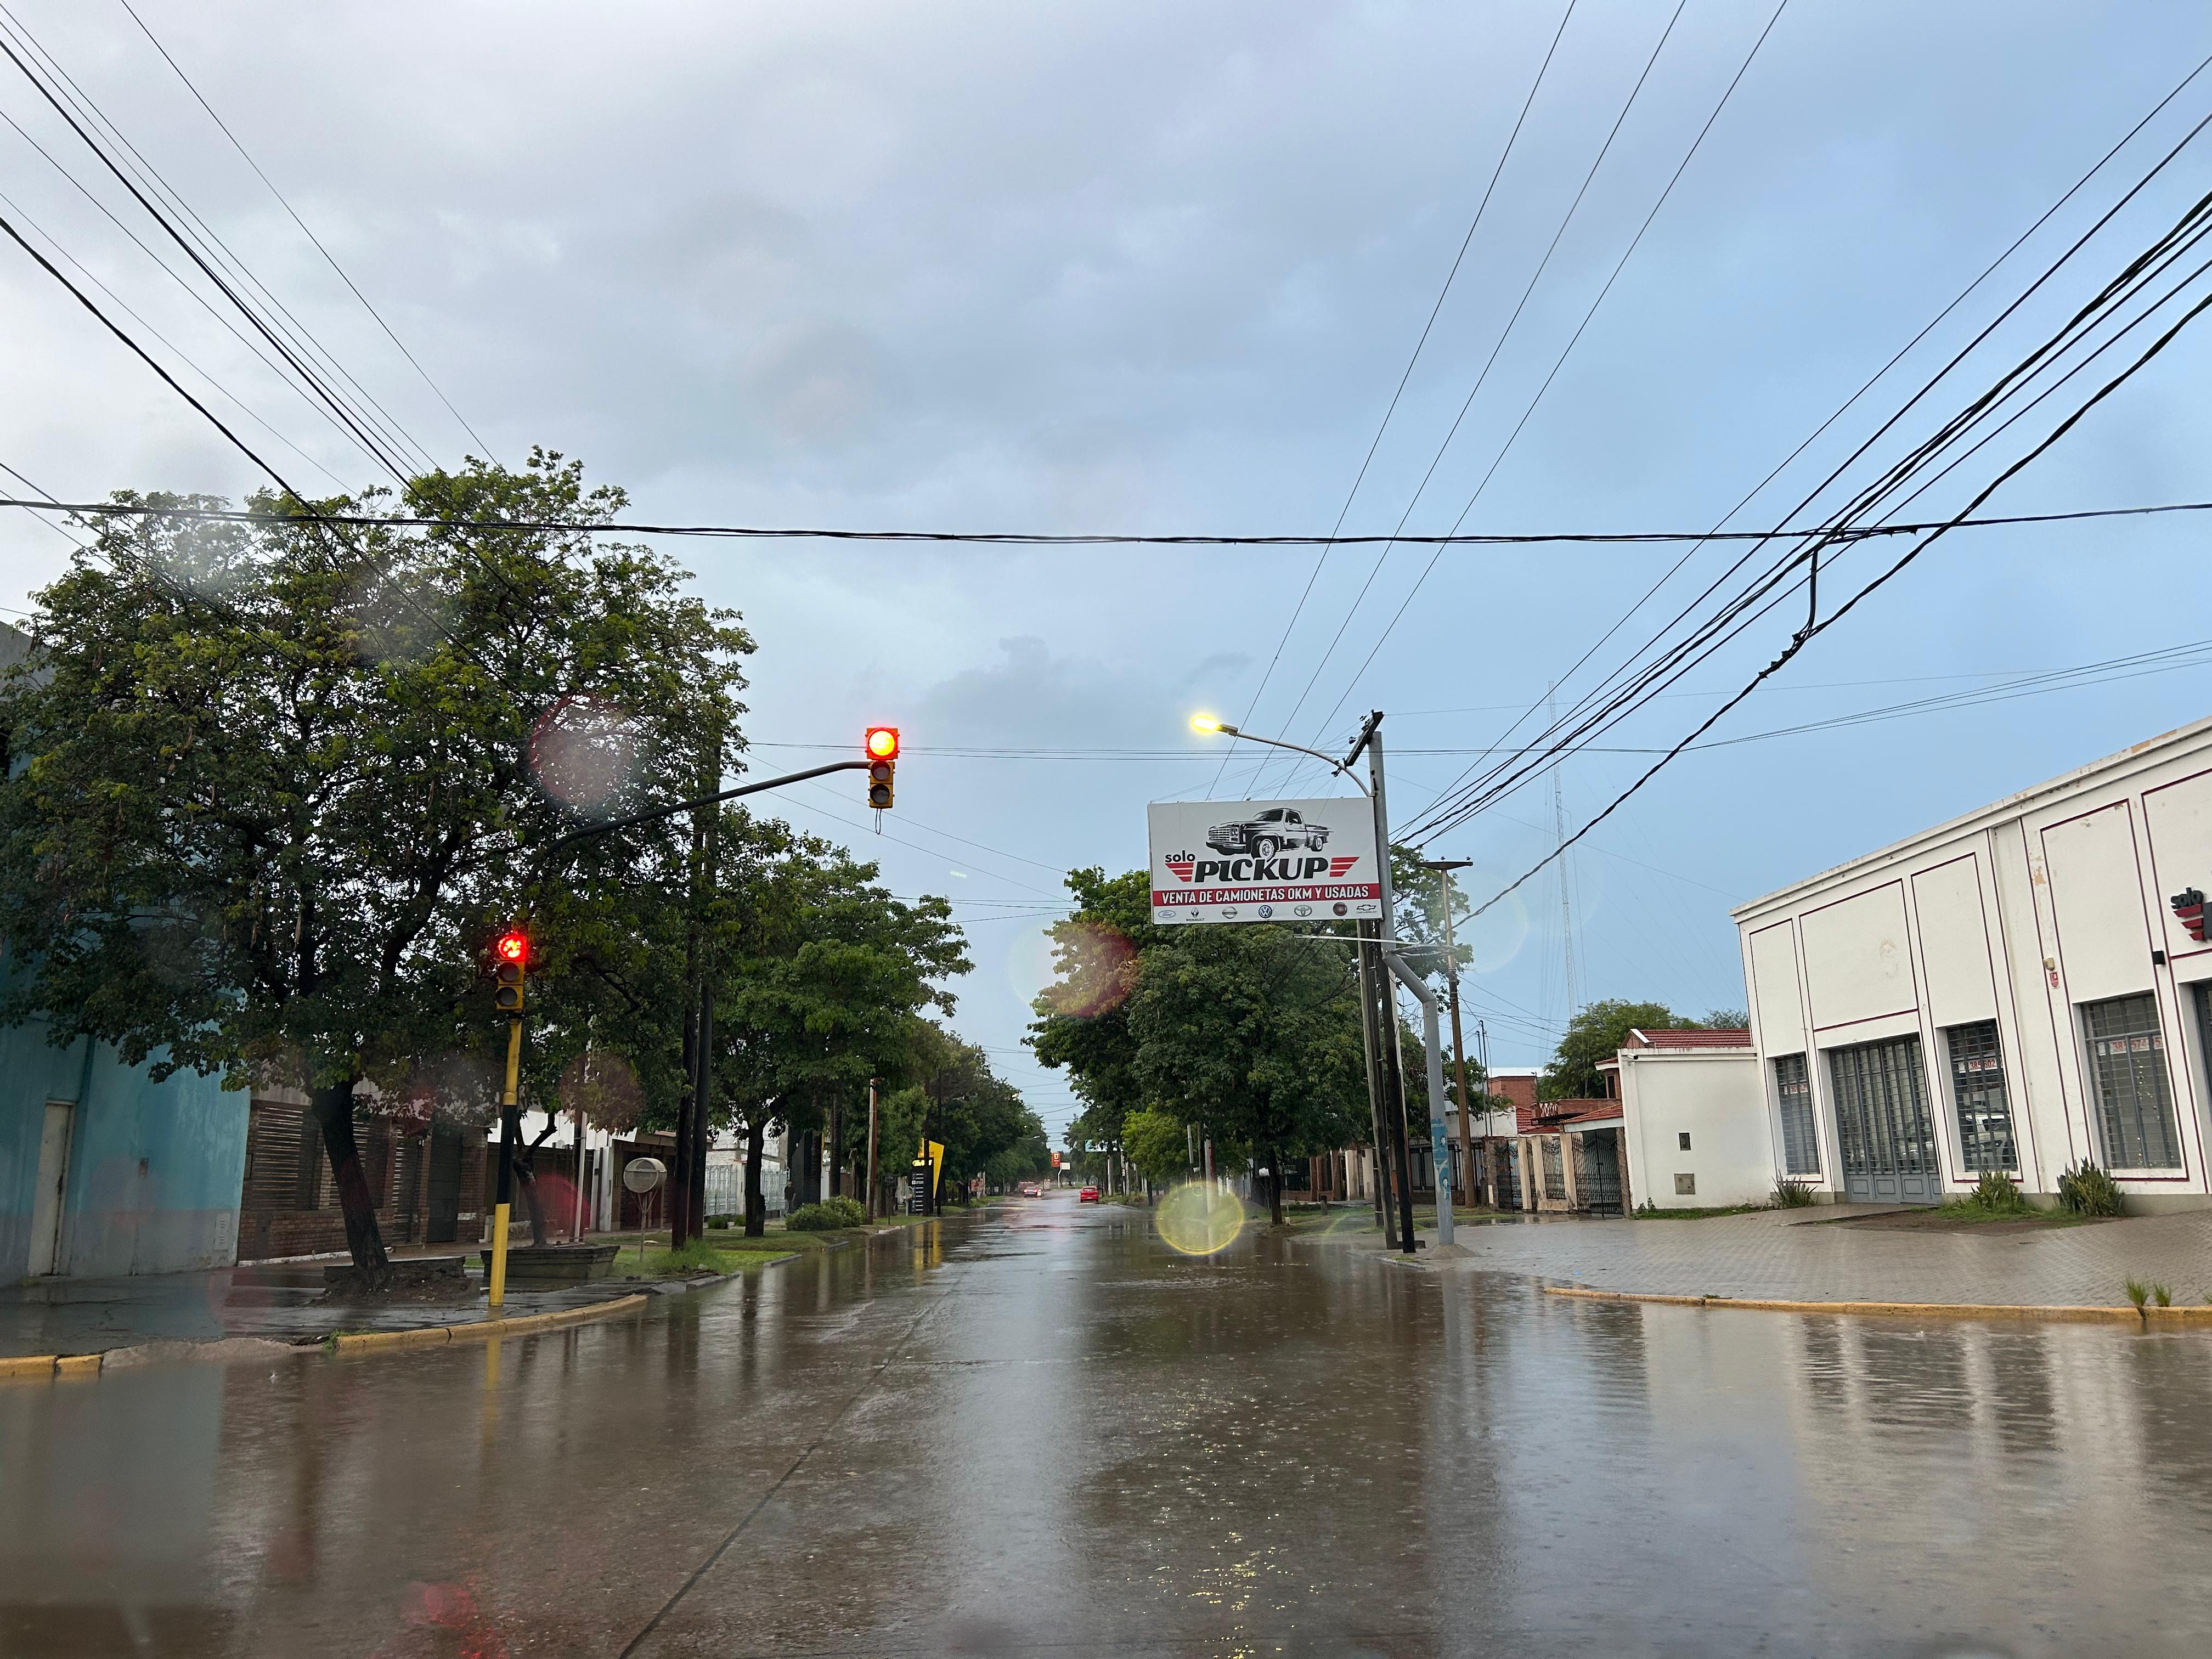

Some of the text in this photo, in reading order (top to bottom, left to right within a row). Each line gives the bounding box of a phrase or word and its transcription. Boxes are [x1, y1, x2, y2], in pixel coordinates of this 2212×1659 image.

[1165, 850, 1195, 862] solo
[1194, 857, 1328, 883] PICKUP
[1161, 891, 1196, 904] VENTA
[1199, 890, 1214, 902] DE
[1216, 888, 1285, 902] CAMIONETAS
[1314, 887, 1322, 899] Y
[1325, 886, 1368, 898] USADAS
[2171, 887, 2203, 909] solo
